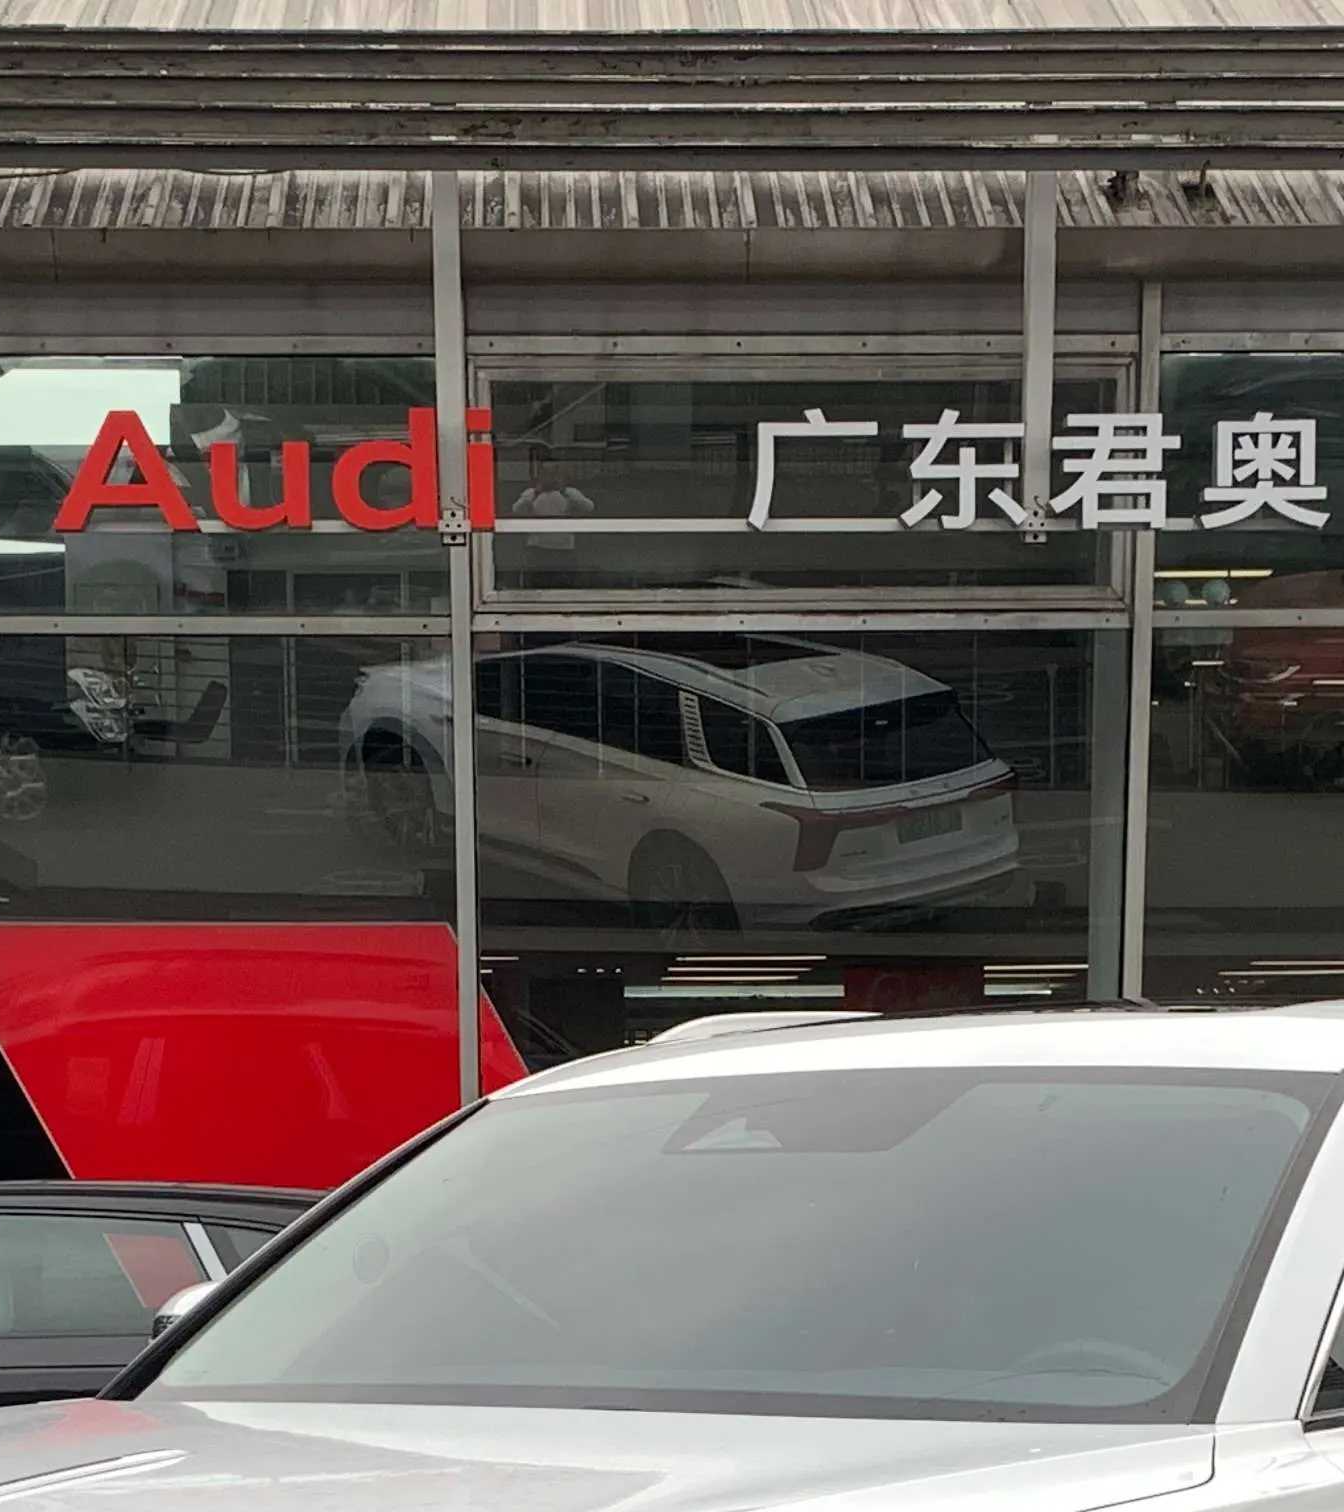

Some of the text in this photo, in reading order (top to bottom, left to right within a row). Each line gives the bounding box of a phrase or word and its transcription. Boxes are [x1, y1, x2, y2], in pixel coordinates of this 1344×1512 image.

[55, 407, 495, 533] Audi
[747, 406, 1332, 530] 广东君奥
